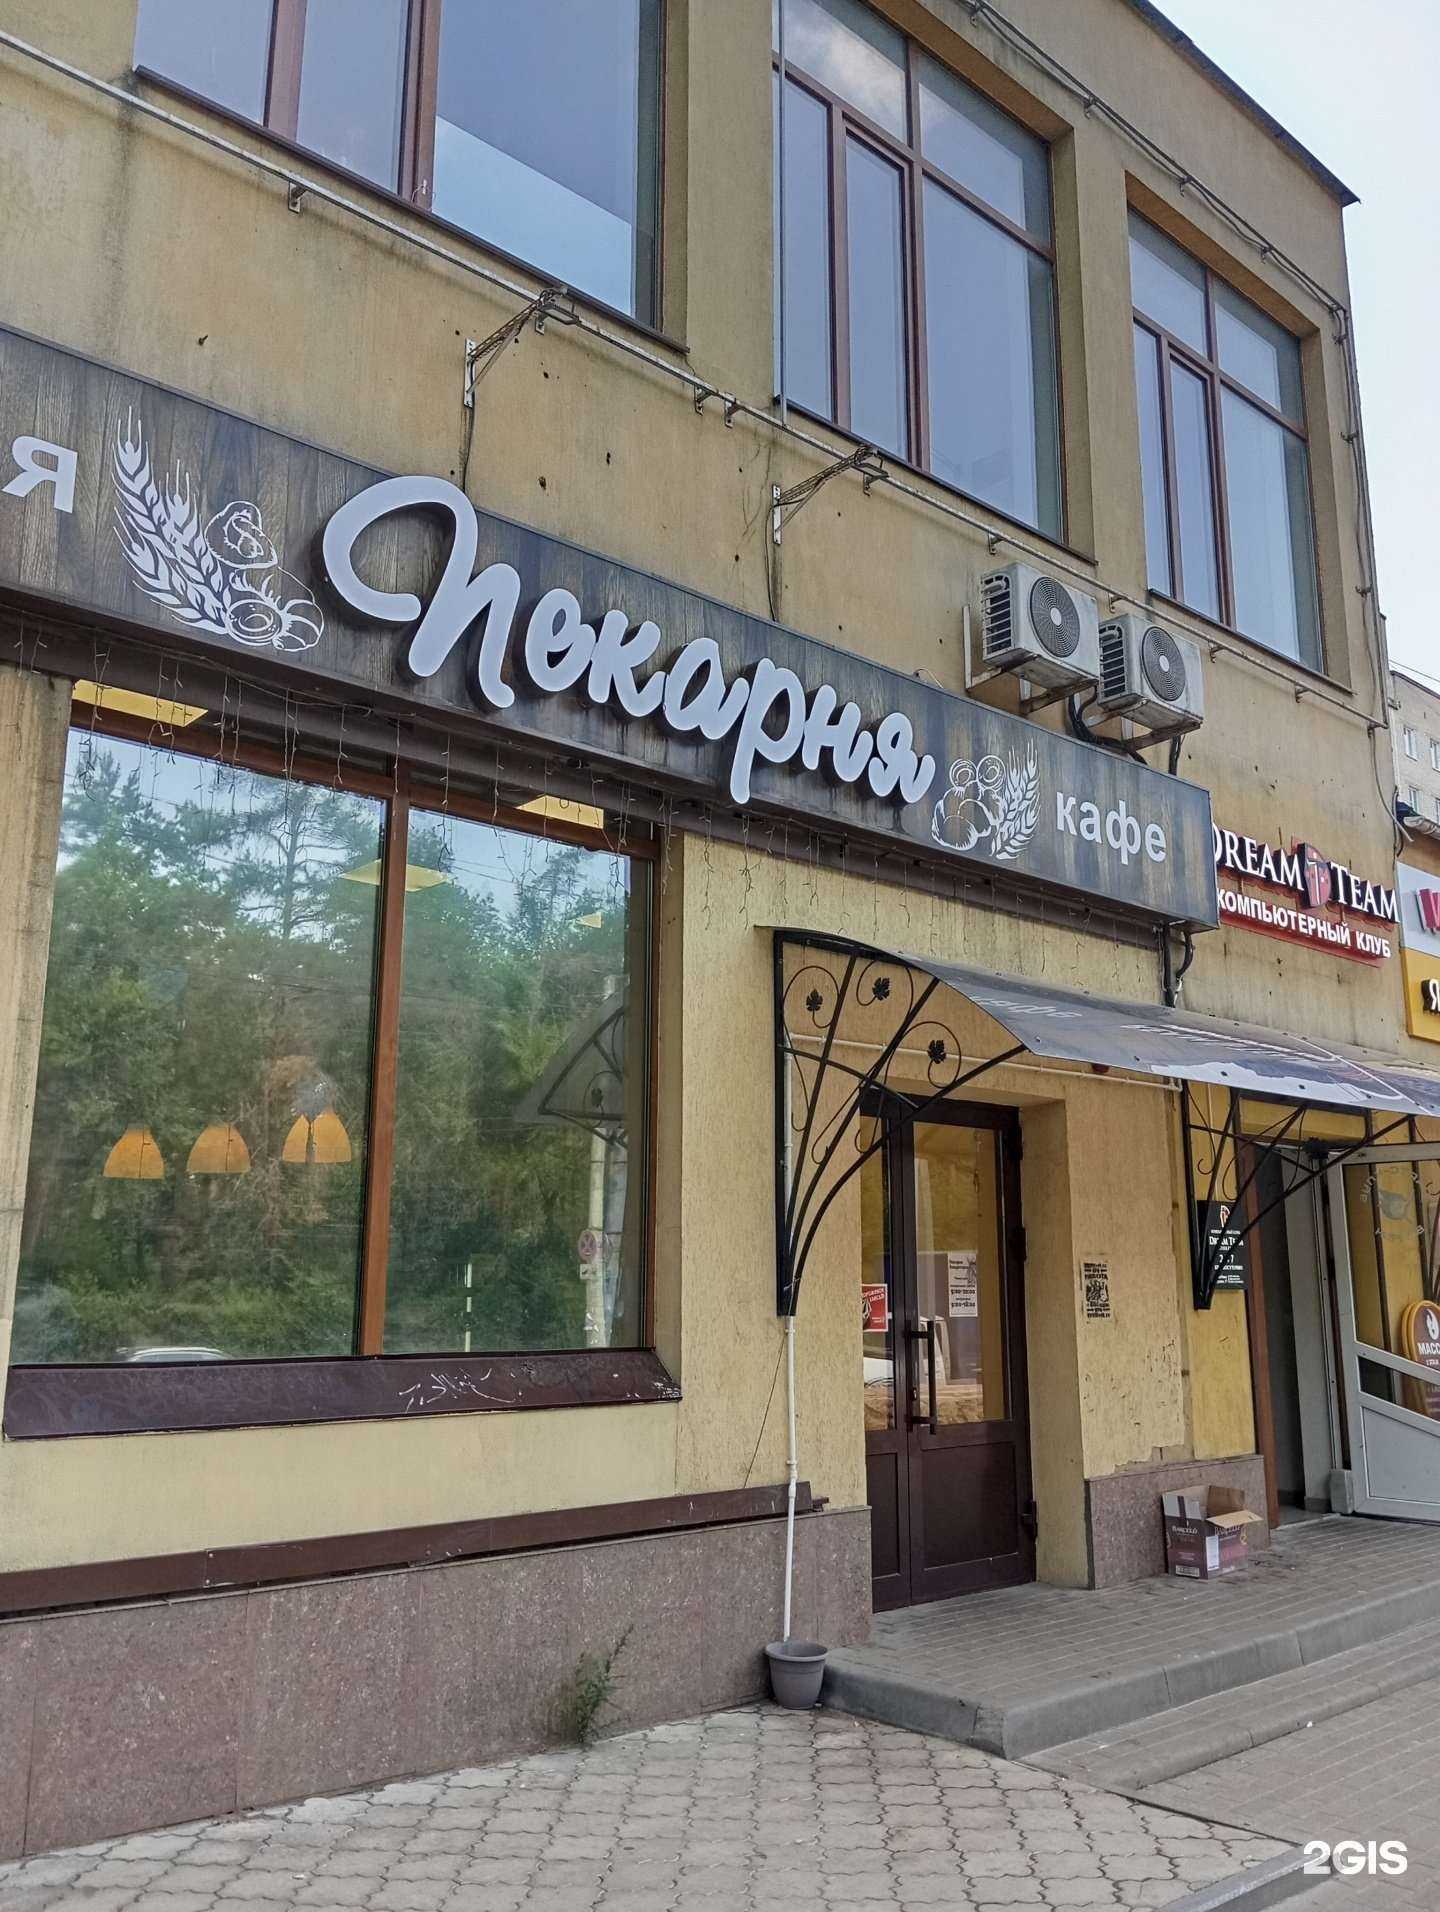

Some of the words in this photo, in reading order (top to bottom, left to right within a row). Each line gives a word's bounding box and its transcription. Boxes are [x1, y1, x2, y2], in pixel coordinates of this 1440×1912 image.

[322, 475, 935, 804] Пекарня
[1056, 791, 1167, 866] кафе
[1217, 887, 1351, 947] КОМПЬЮТЕРНЫЙ
[1356, 931, 1392, 958] КЛУБ
[1331, 863, 1400, 923] TEAM
